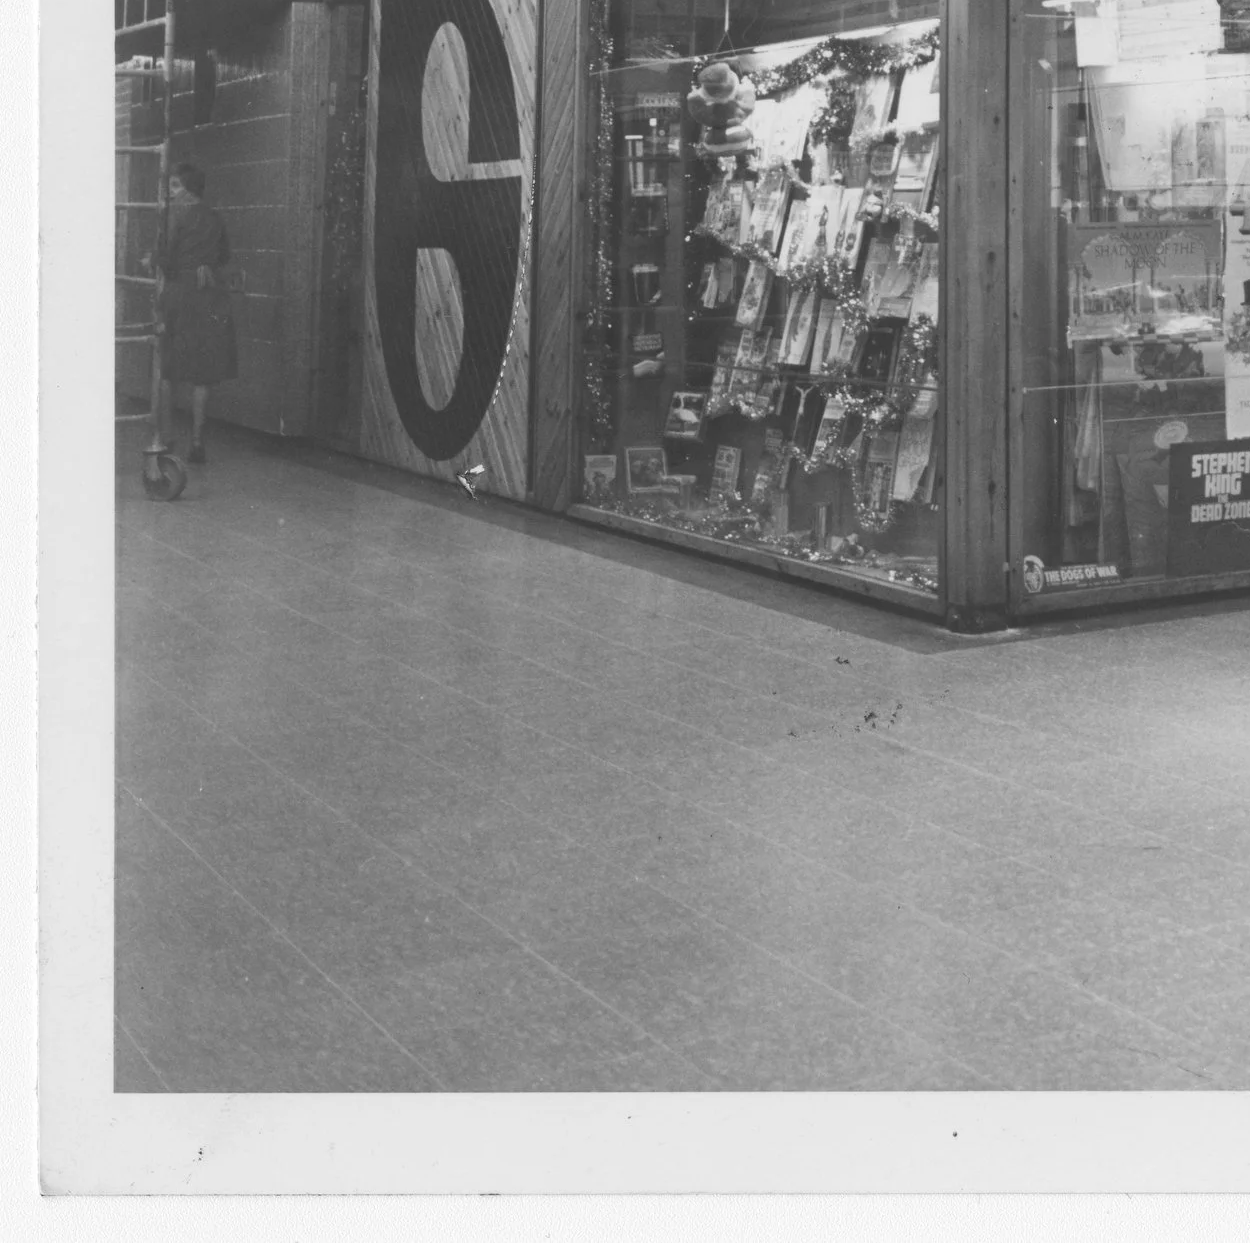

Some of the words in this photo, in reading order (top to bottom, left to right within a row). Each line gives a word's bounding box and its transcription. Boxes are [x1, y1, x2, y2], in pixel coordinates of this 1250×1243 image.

[1205, 473, 1242, 497] KING
[1191, 504, 1222, 522] DEAD
[1044, 570, 1060, 582] THE
[1060, 569, 1084, 581] DOGS
[1084, 567, 1096, 579] OF
[1096, 565, 1119, 577] WAR
